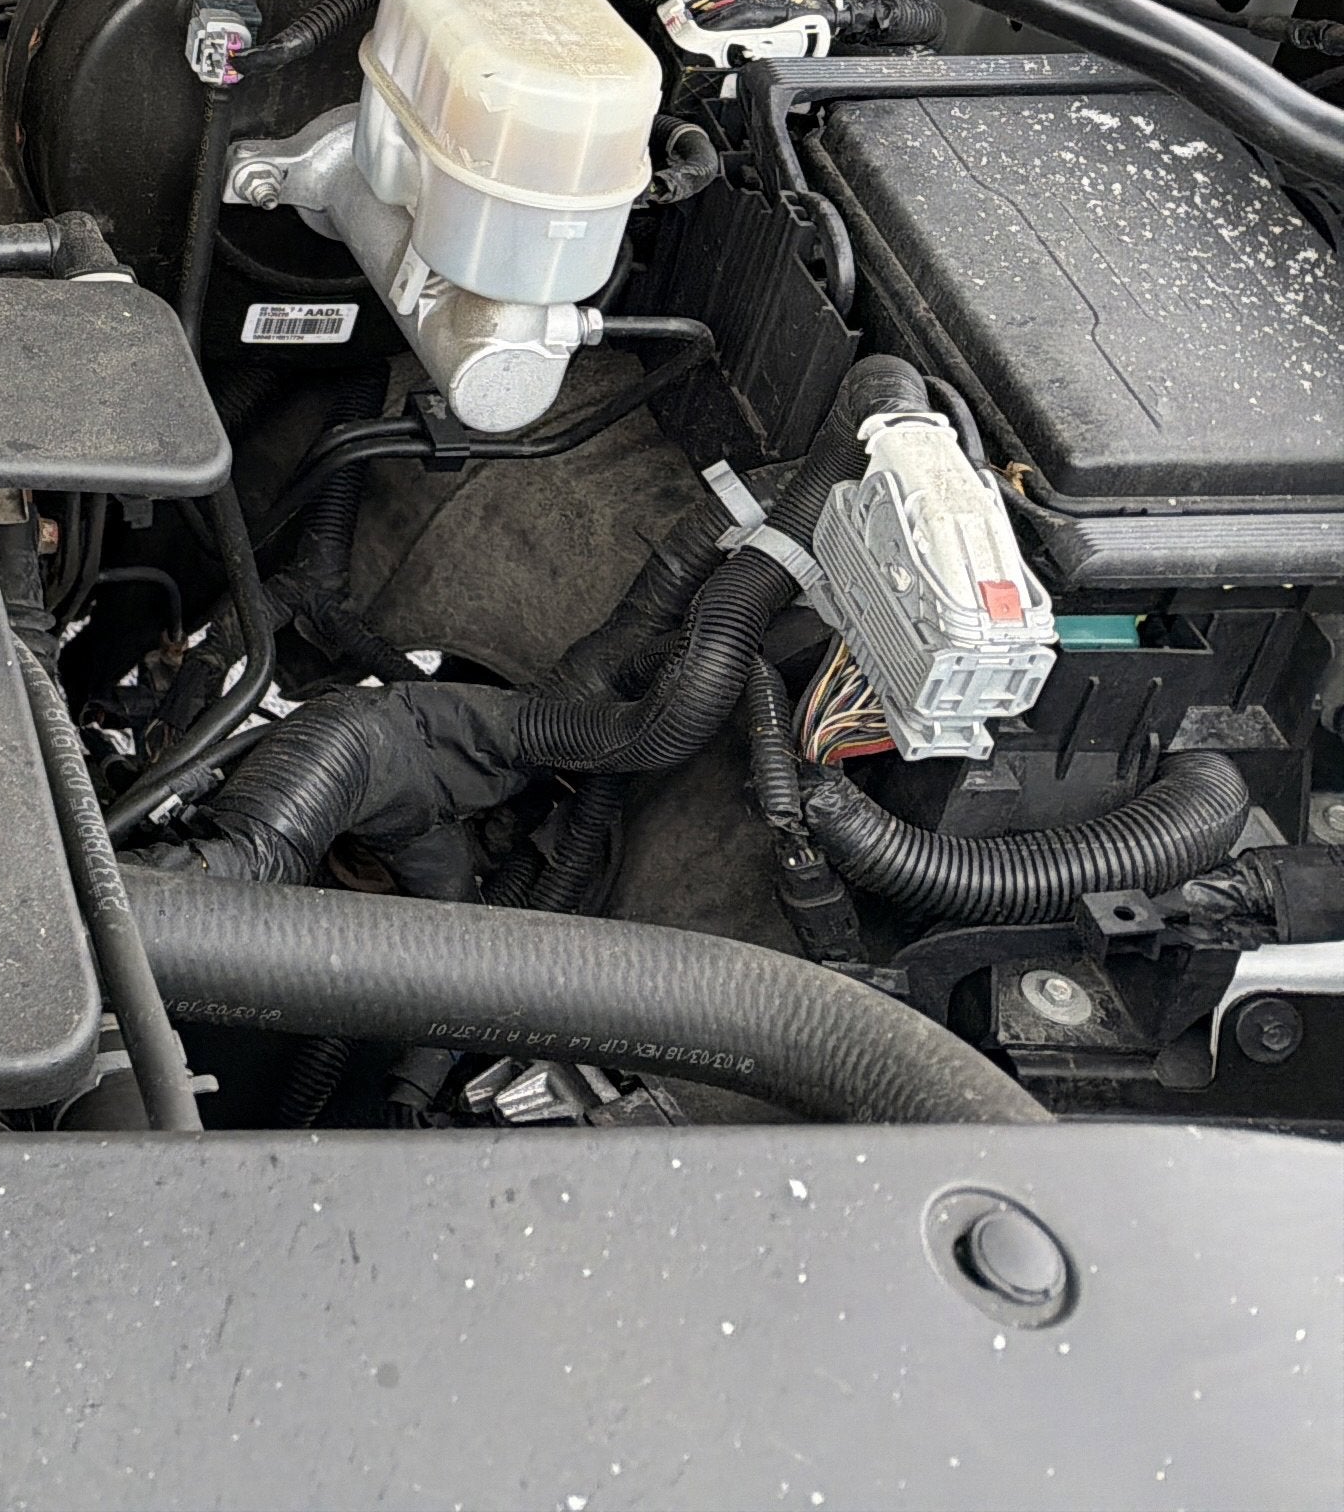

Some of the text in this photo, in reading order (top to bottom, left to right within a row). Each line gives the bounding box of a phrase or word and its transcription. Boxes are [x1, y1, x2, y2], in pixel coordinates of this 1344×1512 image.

[304, 308, 344, 317] AADL
[71, 795, 131, 912] 23378805
[598, 1038, 628, 1054] CIP
[632, 1041, 664, 1058] MEX
[667, 1045, 734, 1070] 03/03/18
[736, 1055, 756, 1074] GM
